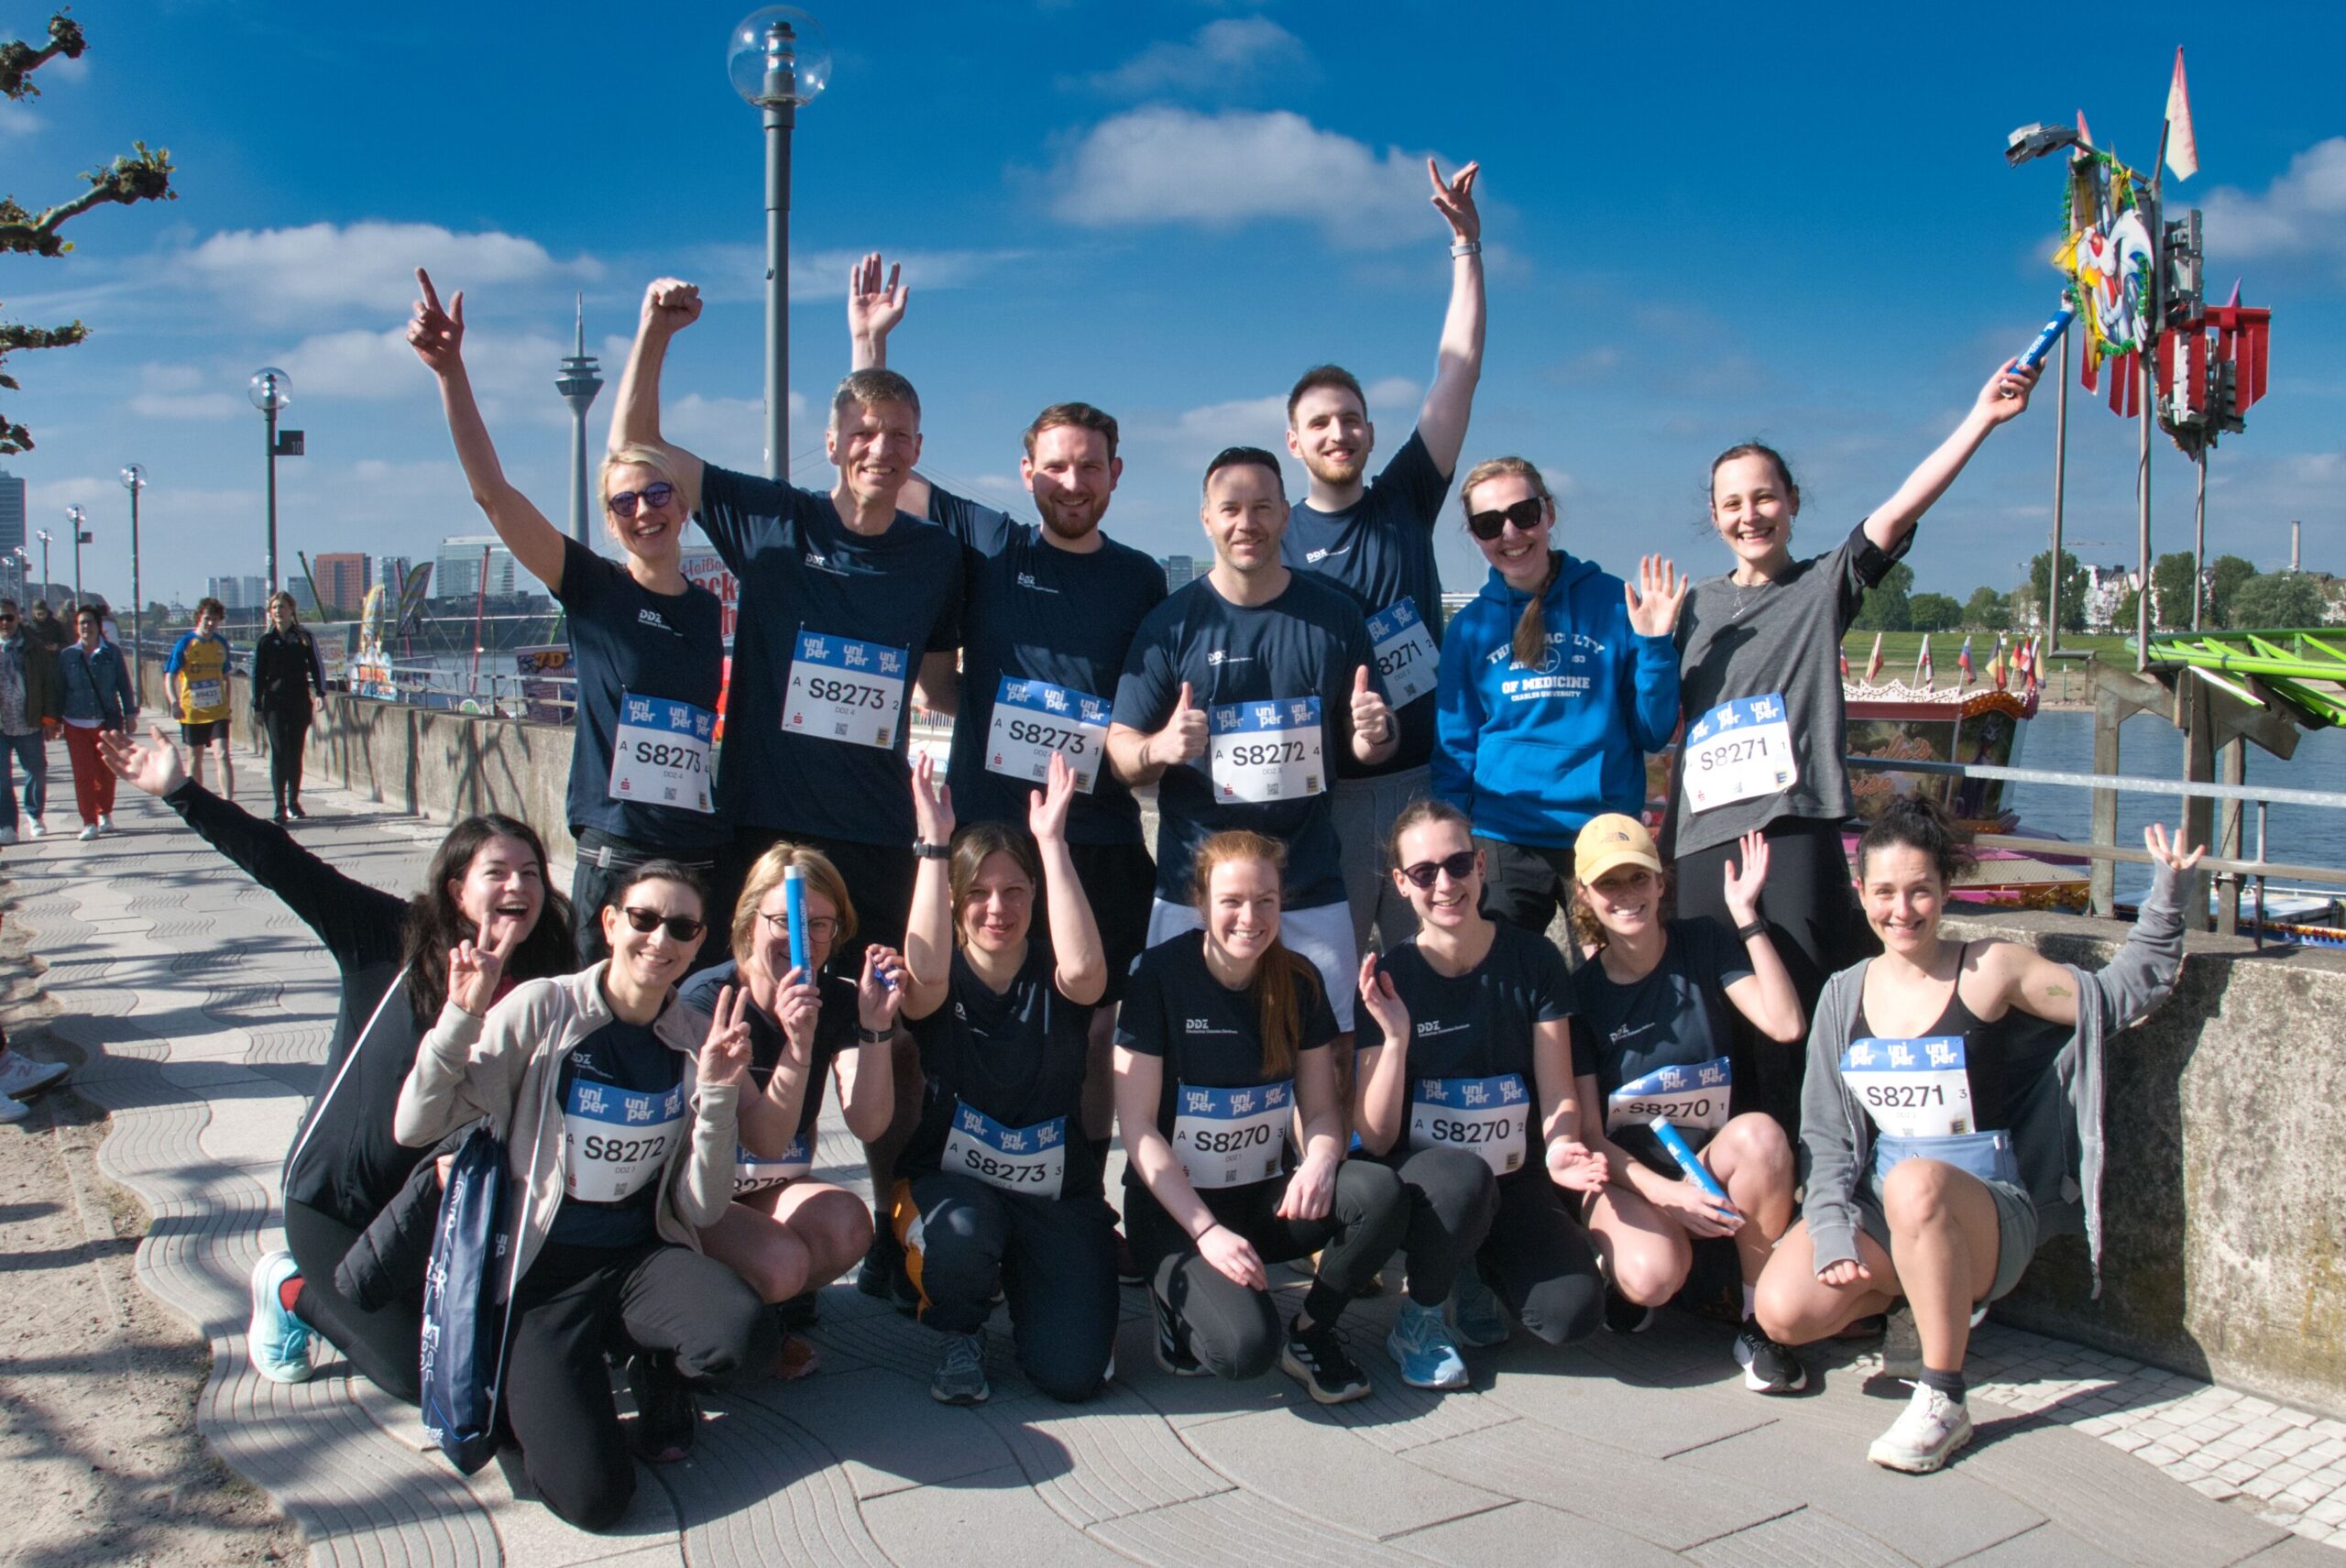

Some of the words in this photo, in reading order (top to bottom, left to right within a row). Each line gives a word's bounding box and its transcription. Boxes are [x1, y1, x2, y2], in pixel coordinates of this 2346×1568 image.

[1392, 603, 1408, 620] uni
[1398, 609, 1413, 628] per
[804, 637, 825, 651] uni
[843, 644, 863, 656] uni
[805, 647, 830, 660] per
[845, 654, 869, 667] per
[879, 651, 896, 663] uni
[1377, 640, 1423, 676] 8271
[1425, 639, 1434, 649] 2
[880, 659, 901, 674] per
[1006, 682, 1027, 695] uni
[1501, 681, 1518, 694] OF
[1522, 675, 1591, 691] MEDICINE
[793, 676, 802, 686] A
[808, 678, 885, 710] S8273
[892, 700, 899, 711] 2
[1007, 691, 1032, 703] per
[1044, 688, 1065, 701] uni
[1510, 692, 1540, 702] CHARLES
[1540, 690, 1582, 698] UNIVERSITY
[629, 699, 651, 714] uni
[669, 705, 688, 718] uni
[1046, 698, 1069, 712] per
[1080, 698, 1101, 711] uni
[1255, 704, 1276, 718] uni
[1291, 700, 1307, 714] uni
[1749, 697, 1771, 713] uni
[630, 708, 656, 723] per
[1081, 707, 1105, 721] per
[1217, 707, 1236, 720] uni
[1294, 711, 1315, 725] per
[1756, 707, 1779, 723] per
[671, 716, 691, 729] per
[1220, 718, 1244, 731] per
[1259, 715, 1283, 729] per
[994, 718, 1003, 729] A
[1009, 719, 1088, 755] S8273
[1093, 747, 1100, 757] 1
[619, 740, 629, 751] A
[635, 741, 701, 773] S8273
[1215, 750, 1223, 760] A
[1233, 740, 1306, 766] S8272
[1312, 746, 1321, 756] 4
[1701, 737, 1768, 771] S8271
[1186, 1018, 1209, 1029] DDZ
[1417, 1020, 1441, 1034] DDZ
[1887, 1041, 1907, 1056] uni
[1925, 1039, 1949, 1055] uni
[1891, 1054, 1915, 1069] per
[1931, 1052, 1957, 1068] per
[1659, 1069, 1680, 1081] uni
[1699, 1063, 1719, 1078] uni
[1422, 1079, 1442, 1091] uni
[1500, 1077, 1517, 1091] uni
[1662, 1079, 1688, 1091] per
[1702, 1071, 1727, 1085] per
[578, 1087, 603, 1102] uni
[1266, 1085, 1282, 1100] uni
[1426, 1088, 1449, 1100] per
[1462, 1082, 1484, 1095] uni
[1503, 1087, 1523, 1102] per
[663, 1090, 679, 1108] uni
[1187, 1091, 1209, 1102] uni
[1231, 1091, 1251, 1103] uni
[1266, 1093, 1285, 1109] per
[1466, 1093, 1490, 1106] per
[1866, 1084, 1944, 1108] S8271
[1957, 1089, 1968, 1099] 3
[579, 1100, 608, 1114] per
[625, 1097, 650, 1111] uni
[664, 1100, 683, 1120] per
[1189, 1101, 1216, 1113] per
[1233, 1101, 1255, 1115] per
[1628, 1099, 1710, 1119] S8270
[1720, 1102, 1725, 1111] 1
[627, 1108, 654, 1123] per
[963, 1110, 982, 1126] uni
[964, 1120, 988, 1135] per
[1036, 1122, 1054, 1138] uni
[1415, 1119, 1423, 1129] A
[1431, 1119, 1510, 1143] S8270
[1517, 1122, 1525, 1133] 2
[1001, 1132, 1022, 1144] uni
[1002, 1139, 1027, 1151] per
[1039, 1130, 1058, 1148] per
[1178, 1131, 1186, 1140] A
[1195, 1124, 1270, 1153] S8270
[566, 1133, 575, 1145] A
[584, 1135, 666, 1163] S8272
[949, 1143, 959, 1153] A
[965, 1149, 1047, 1182] S8273
[1055, 1166, 1062, 1176] 3
